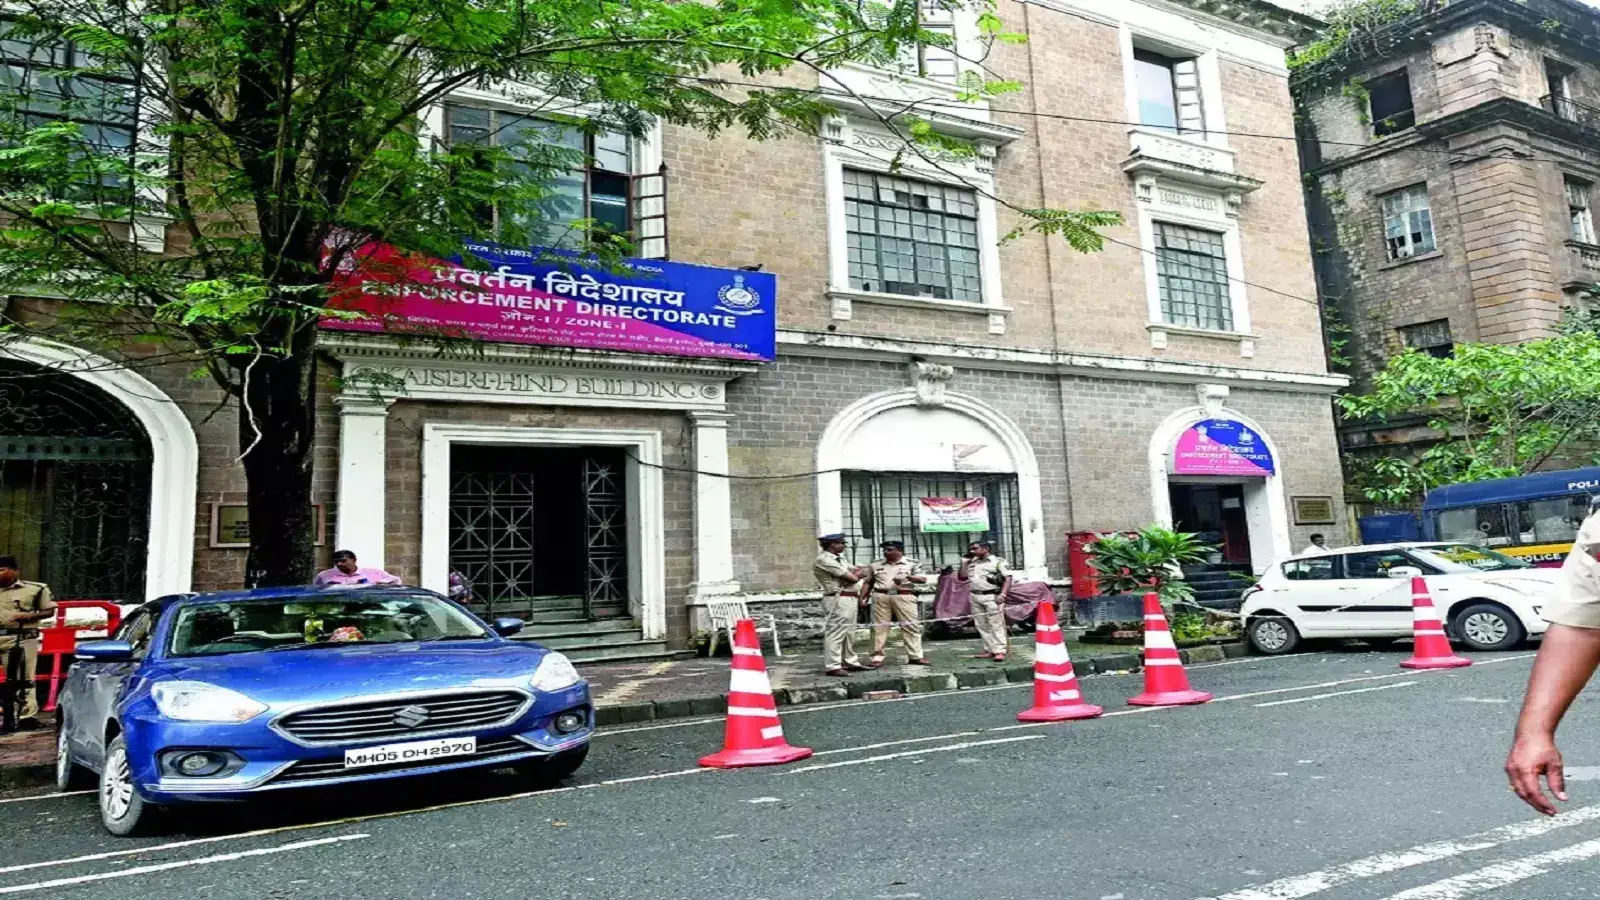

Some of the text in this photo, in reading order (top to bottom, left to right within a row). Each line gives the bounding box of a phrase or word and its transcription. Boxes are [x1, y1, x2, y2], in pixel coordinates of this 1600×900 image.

[636, 264, 664, 273] INDIA
[544, 271, 686, 308] निदेशालय
[362, 280, 737, 328] ENFORCEMENT DIRECTORATE
[576, 377, 697, 398] BUILDING
[346, 751, 399, 765] MH05
